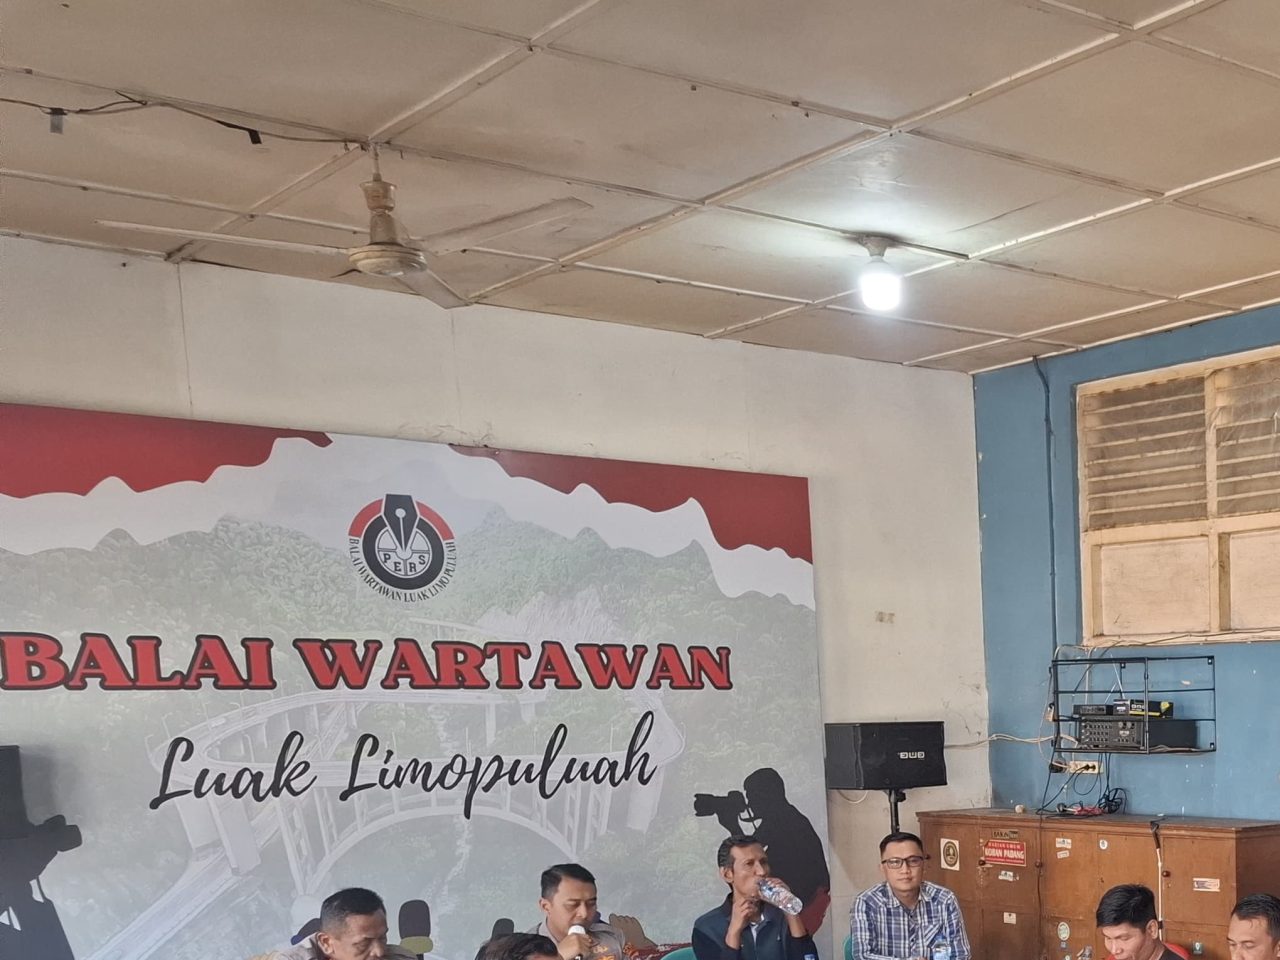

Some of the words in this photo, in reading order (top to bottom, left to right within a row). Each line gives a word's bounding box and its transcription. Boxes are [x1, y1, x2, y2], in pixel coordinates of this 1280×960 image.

[357, 564, 401, 601] WARTAWAN
[404, 589, 428, 602] LUAK
[382, 553, 426, 573] PERS
[0, 632, 277, 690] BALAI
[292, 637, 733, 690] WARTAWAN
[149, 730, 317, 810] Luak
[339, 710, 657, 820] Limopuluah
